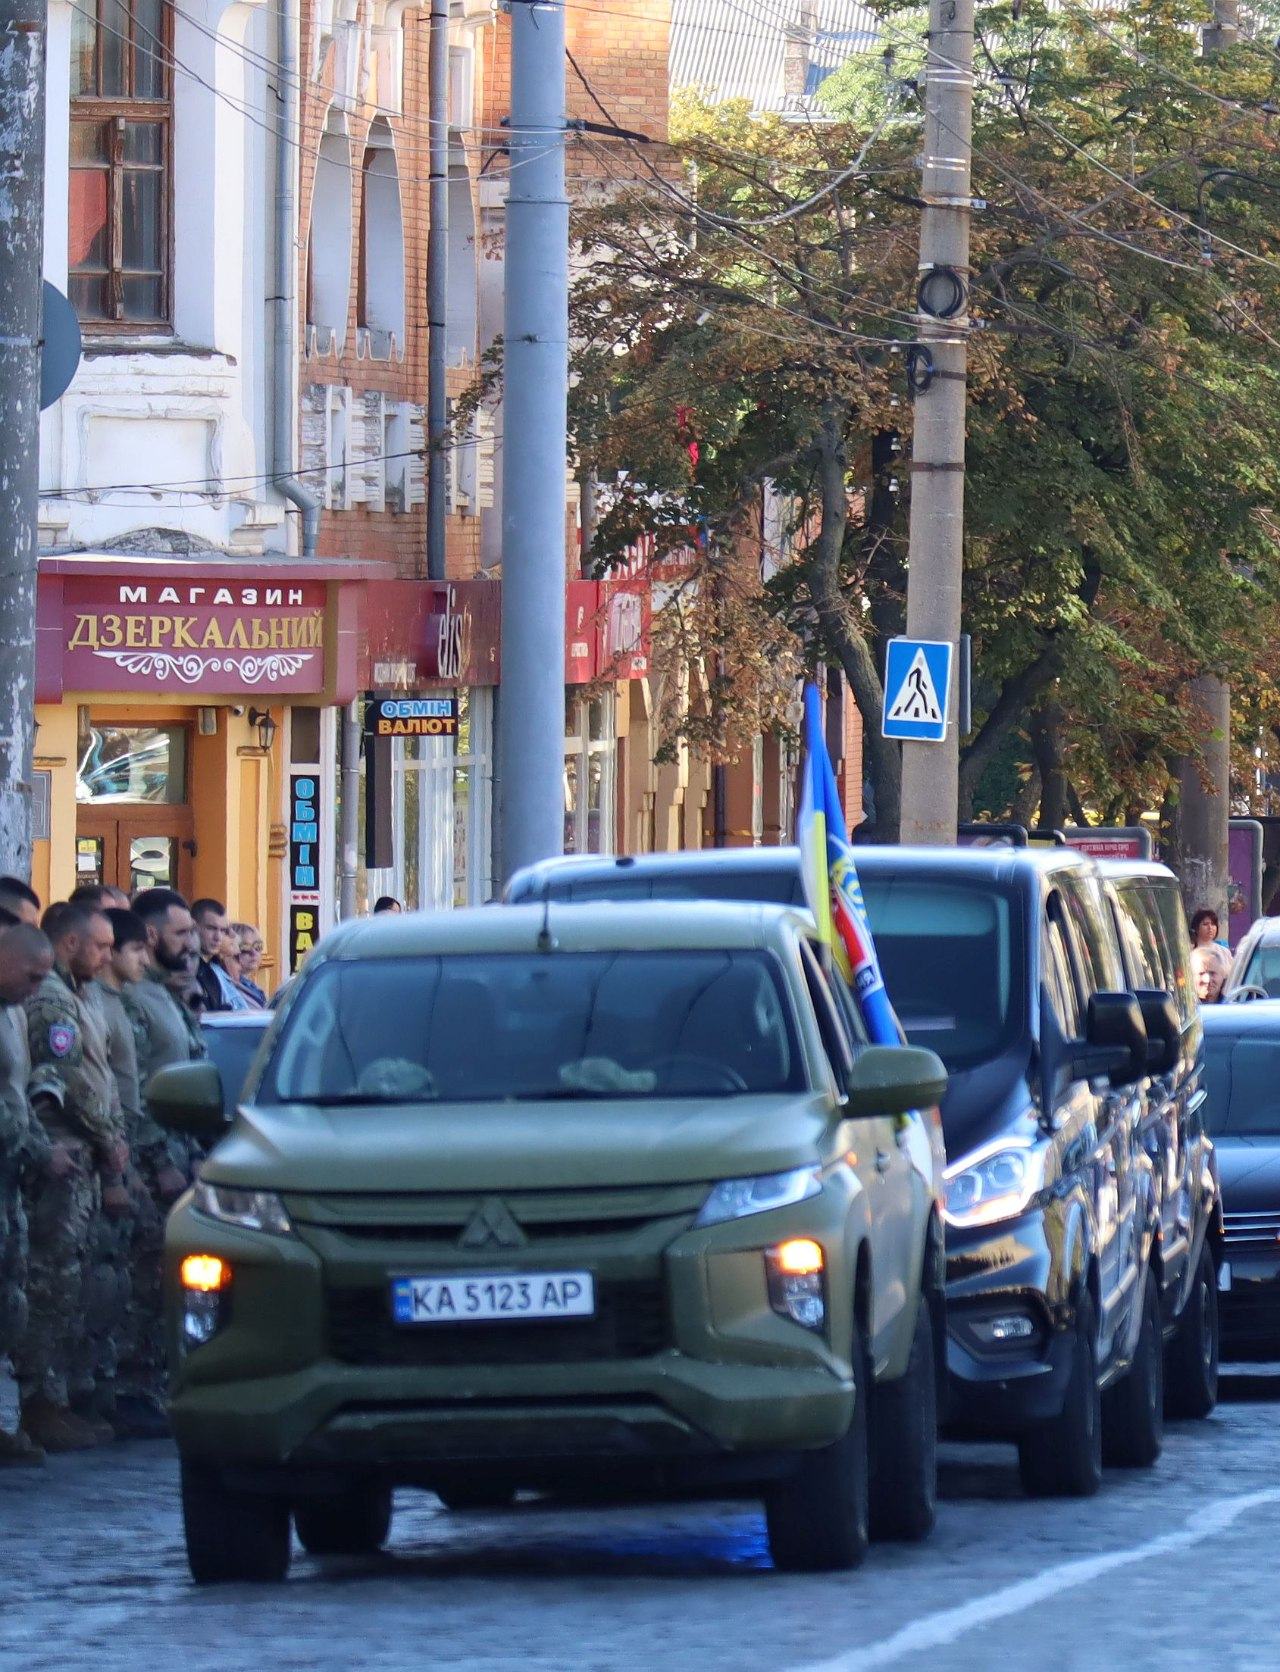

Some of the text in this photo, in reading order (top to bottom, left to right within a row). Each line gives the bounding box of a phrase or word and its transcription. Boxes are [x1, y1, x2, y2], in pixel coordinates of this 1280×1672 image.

[119, 585, 303, 606] МАГАЗИН
[67, 610, 324, 651] ДЗЕРКАЛЬНИЙ
[380, 700, 451, 718] ОБМІН
[378, 719, 455, 735] ВАЛЮТ
[293, 779, 317, 887] ОБМІН
[465, 1284, 531, 1311] 5123
